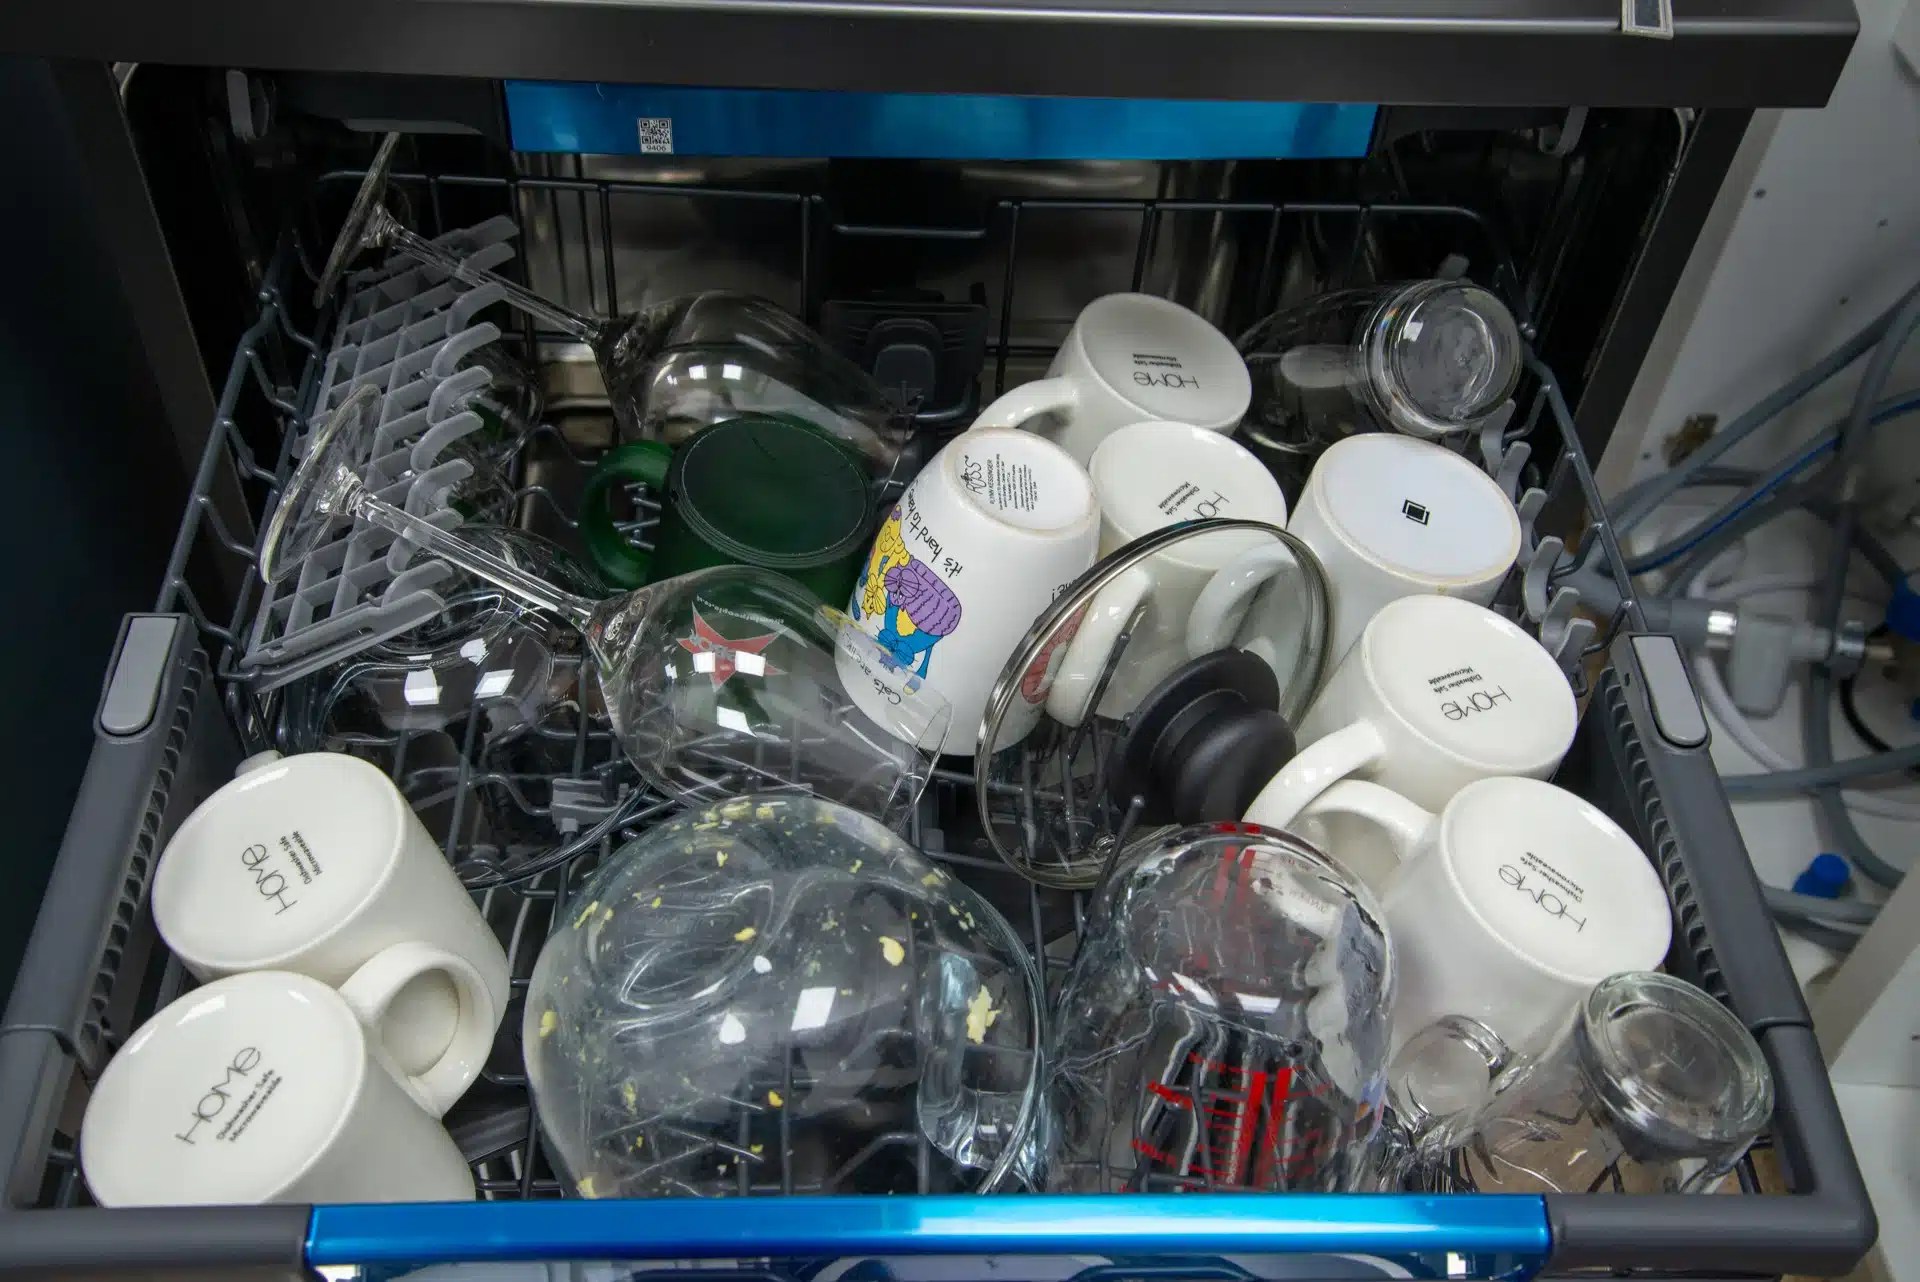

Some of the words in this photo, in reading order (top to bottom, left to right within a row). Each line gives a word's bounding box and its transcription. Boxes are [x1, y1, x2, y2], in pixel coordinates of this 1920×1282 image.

[909, 511, 921, 533] to
[915, 526, 943, 563] hard
[873, 678, 902, 705] Cats
[280, 836, 292, 851] Safe
[289, 850, 312, 884] Dishwasher
[1520, 856, 1537, 871] Safe
[1526, 852, 1584, 894] Microwaveable
[1540, 870, 1582, 902] Dishwasher
